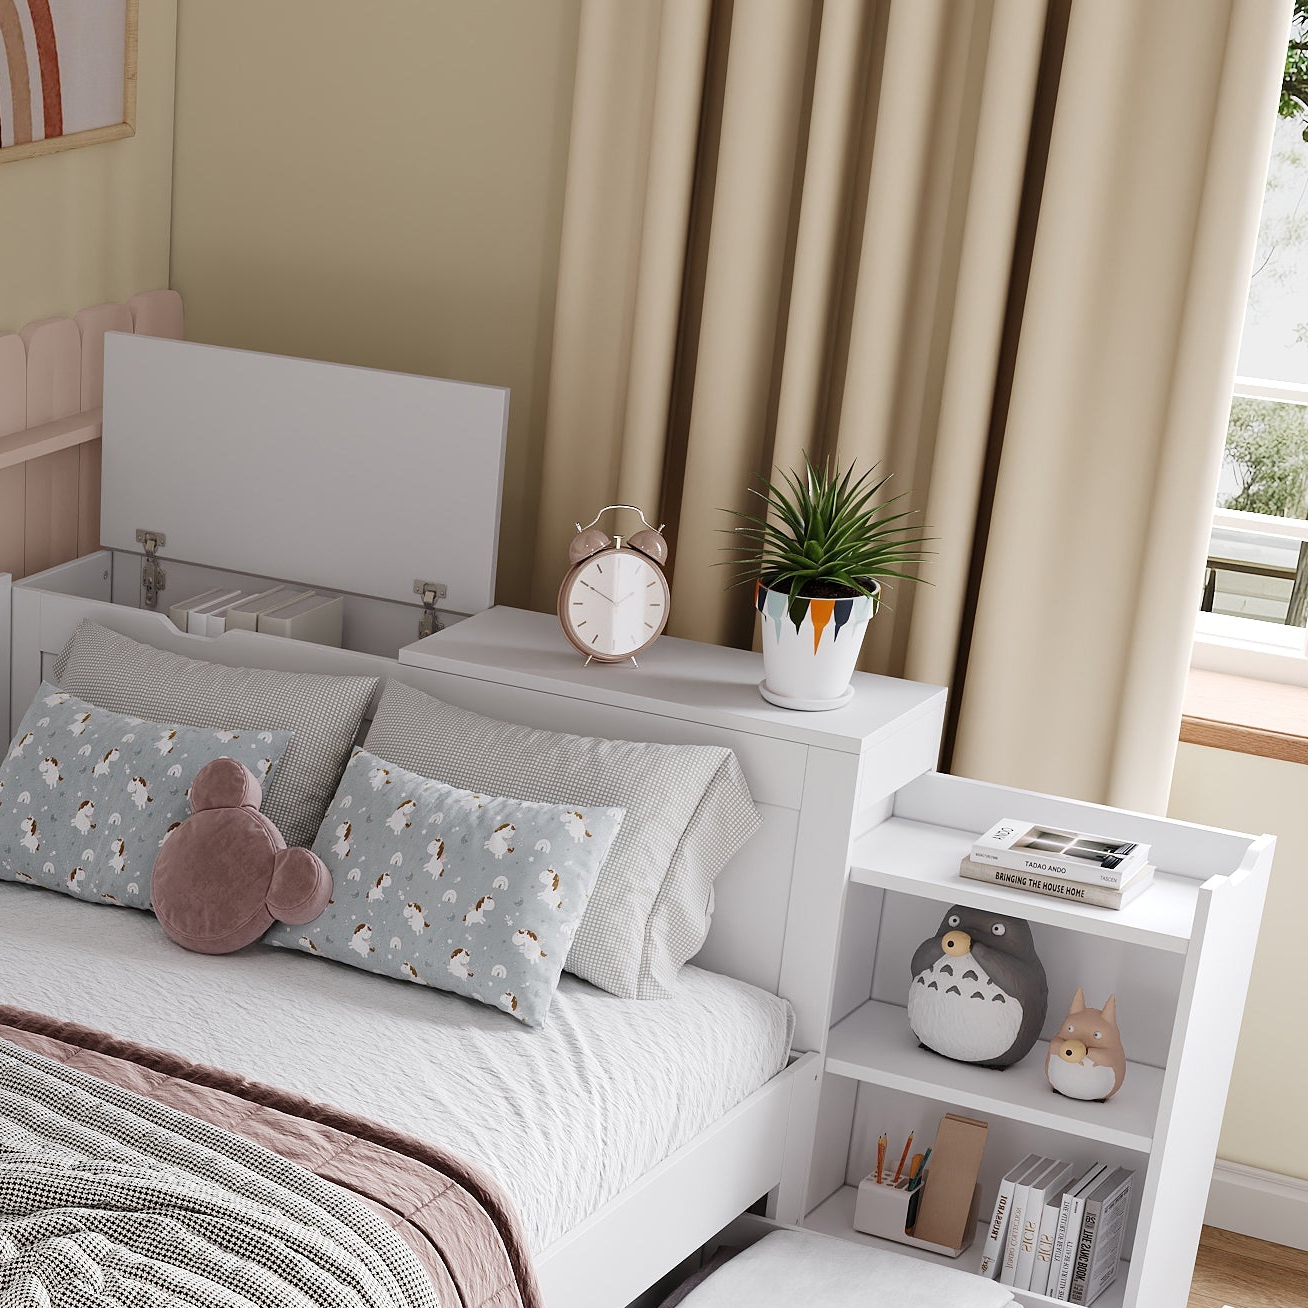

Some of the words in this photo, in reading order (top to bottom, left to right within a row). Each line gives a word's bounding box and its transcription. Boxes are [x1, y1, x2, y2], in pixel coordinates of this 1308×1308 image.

[1025, 860, 1046, 871] TADAO
[1048, 864, 1067, 874] ANDO
[995, 871, 1027, 886] BRINGING
[1028, 878, 1041, 889] THE
[1042, 881, 1064, 894] HOUSE
[1065, 887, 1085, 899] HOME
